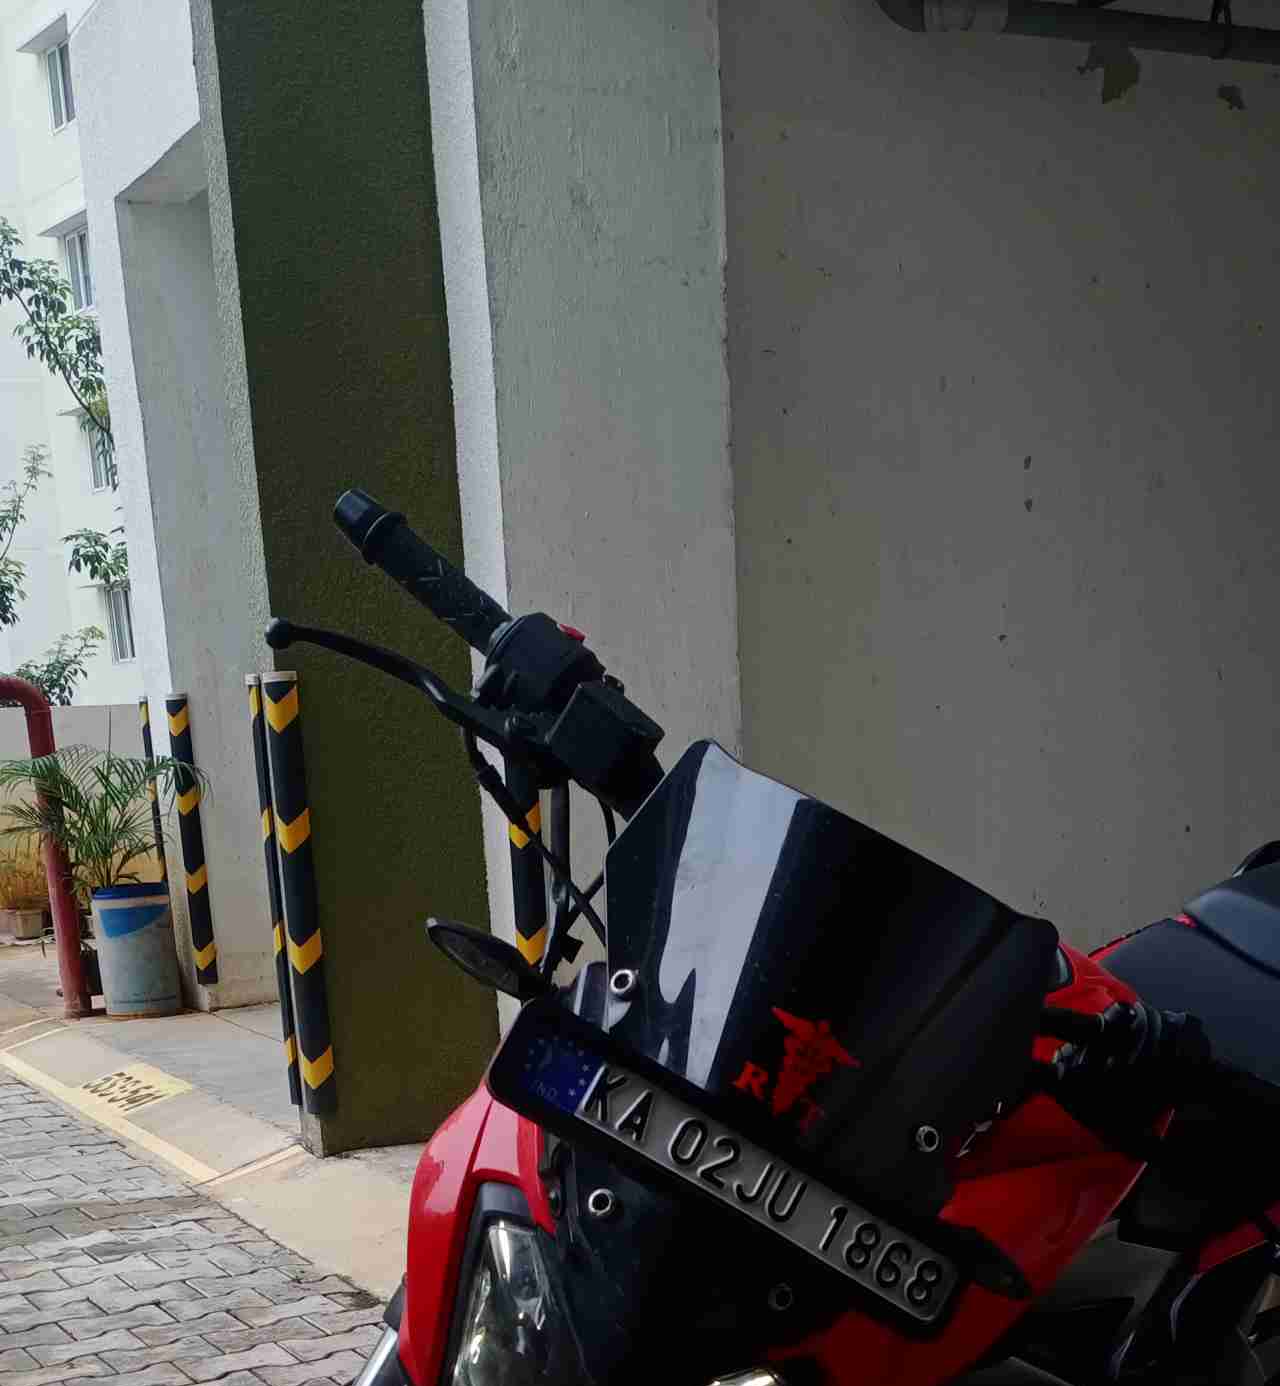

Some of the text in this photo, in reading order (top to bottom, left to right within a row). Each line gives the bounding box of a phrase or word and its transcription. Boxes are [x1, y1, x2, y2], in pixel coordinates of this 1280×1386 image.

[578, 1063, 945, 1305] KA 02JU 1868
